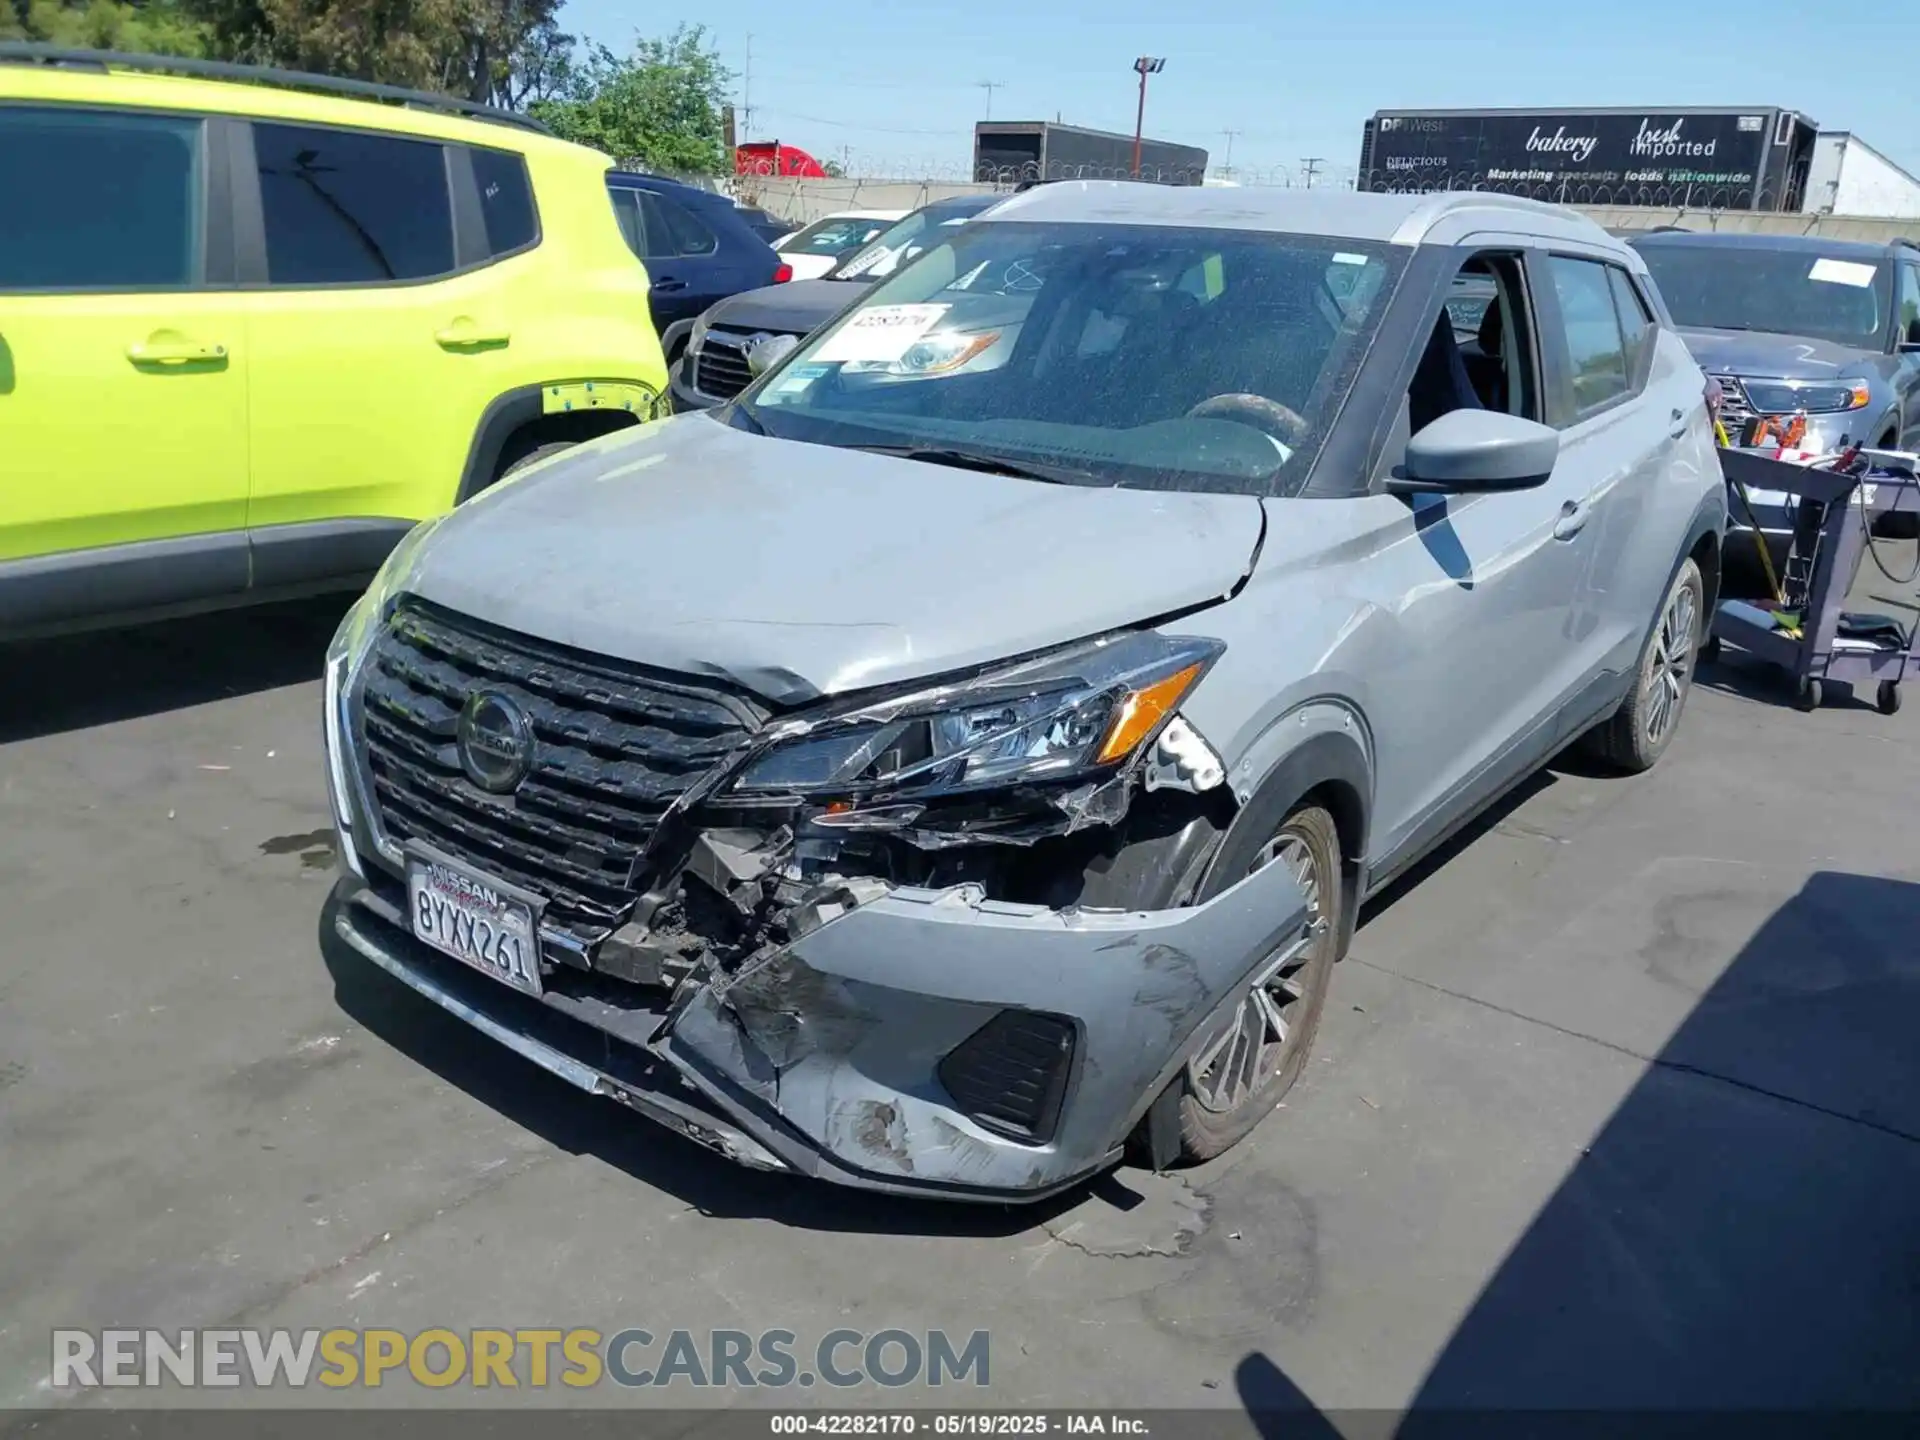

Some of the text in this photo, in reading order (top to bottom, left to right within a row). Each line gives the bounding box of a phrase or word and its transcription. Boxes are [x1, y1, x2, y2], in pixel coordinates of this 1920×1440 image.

[1525, 126, 1599, 162] bakery
[1630, 139, 1717, 159] imported
[1386, 156, 1448, 167] DELICIOUS
[1487, 168, 1553, 182] Marketing
[1624, 170, 1664, 182] foods
[1667, 170, 1752, 183] nationwide
[431, 863, 498, 907] NISSAN
[418, 888, 530, 982] 8YXX261
